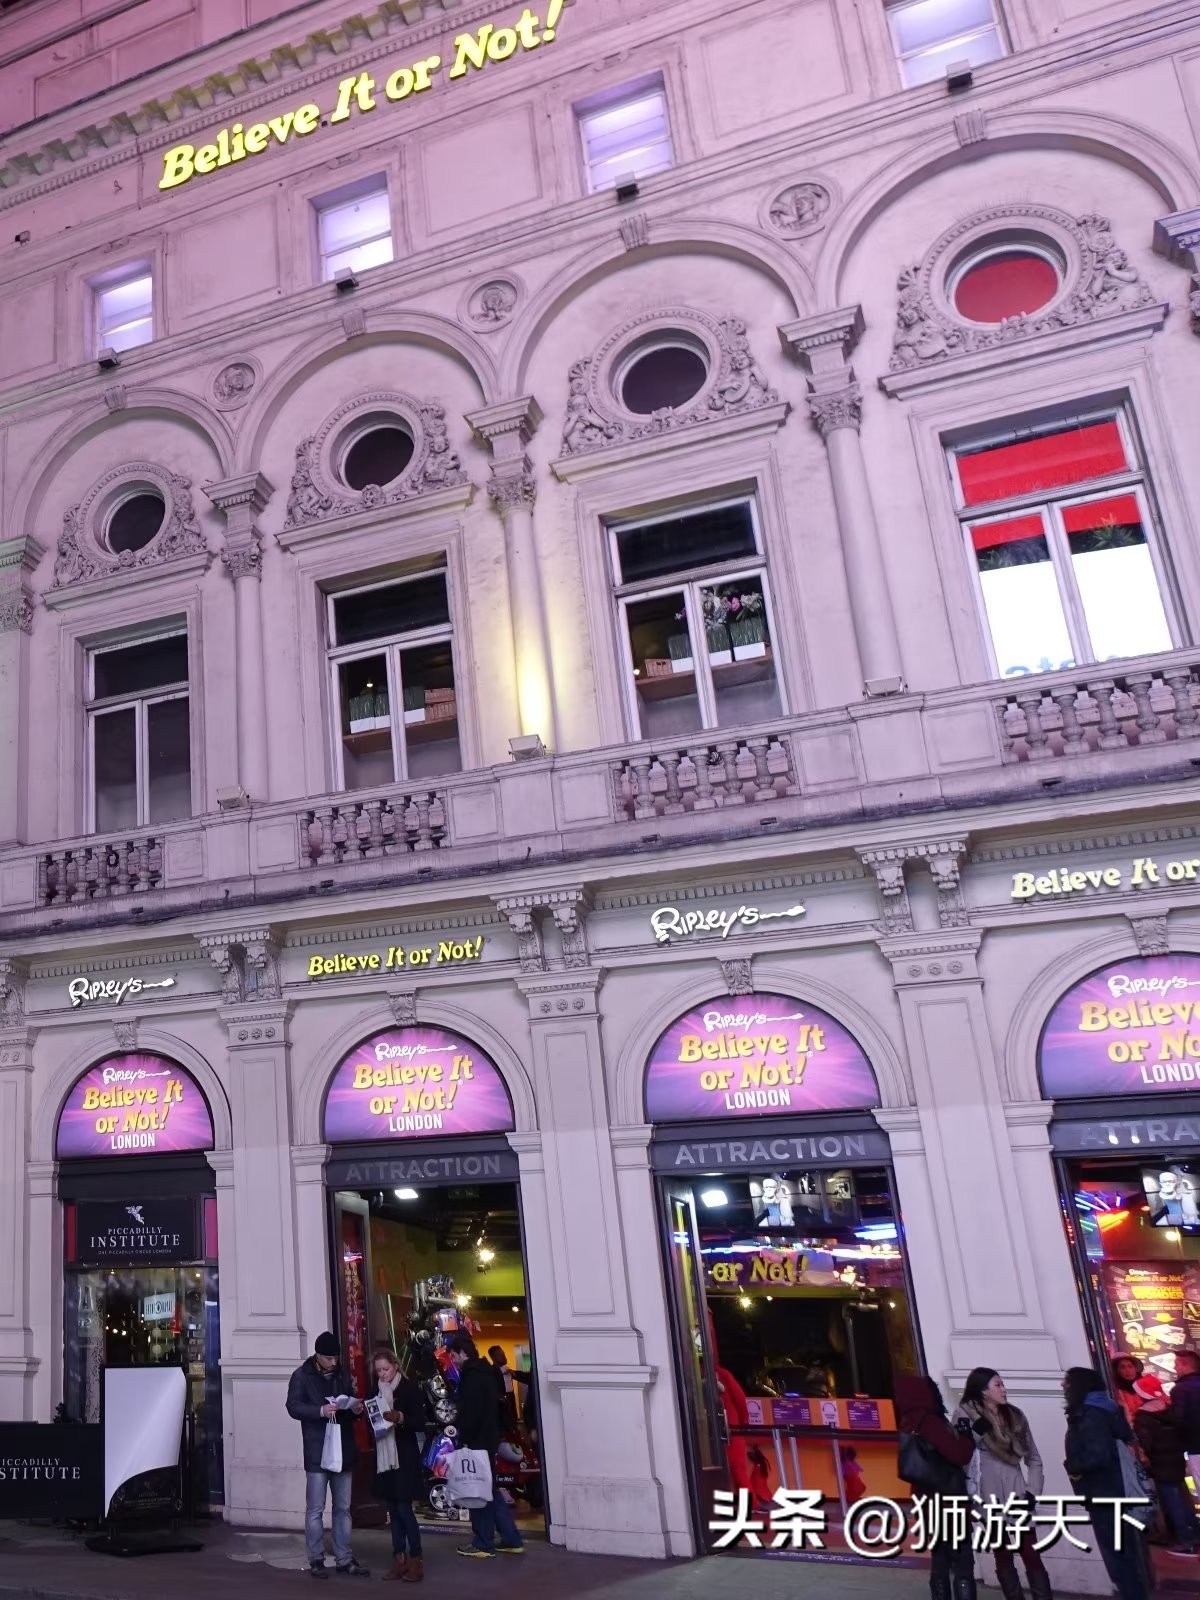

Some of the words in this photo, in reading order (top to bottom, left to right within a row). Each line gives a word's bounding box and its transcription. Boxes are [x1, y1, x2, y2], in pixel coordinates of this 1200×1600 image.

[158, 103, 319, 190] Believe
[330, 71, 376, 123] It
[385, 54, 441, 100] or
[448, 0, 565, 79] Not!
[1011, 867, 1121, 899] Believe
[1131, 857, 1160, 886] It
[1166, 860, 1200, 880] or
[307, 954, 379, 976] Believe
[385, 947, 405, 967] It
[409, 949, 431, 965] or
[436, 936, 484, 962] Not!
[1079, 998, 1200, 1032] Believ
[678, 1031, 788, 1063] Believe
[797, 1024, 826, 1053] It
[1108, 1038, 1152, 1063] or
[1158, 1027, 1200, 1061] No
[352, 1061, 442, 1089] Believe
[449, 1055, 474, 1082] It
[700, 1068, 734, 1091] or
[740, 1056, 807, 1088] Not!
[1141, 1062, 1200, 1084] LOND
[82, 1085, 159, 1110] Believe
[163, 1080, 184, 1104] It
[369, 1096, 397, 1115] or
[402, 1086, 458, 1113] Not!
[725, 1089, 791, 1110] LONDON
[96, 1117, 119, 1134] or
[122, 1105, 169, 1133] Not!
[389, 1113, 443, 1132] LONDON
[1079, 1119, 1200, 1145] ATTRA
[111, 1133, 155, 1150] LONDON
[675, 1135, 866, 1165] ATTRACTION
[346, 1155, 501, 1182] ATTRACTION
[91, 1234, 180, 1248] INSTITUTE
[108, 1227, 163, 1235] PICCADILLY
[713, 1262, 743, 1282] or
[751, 1255, 809, 1283] Not!
